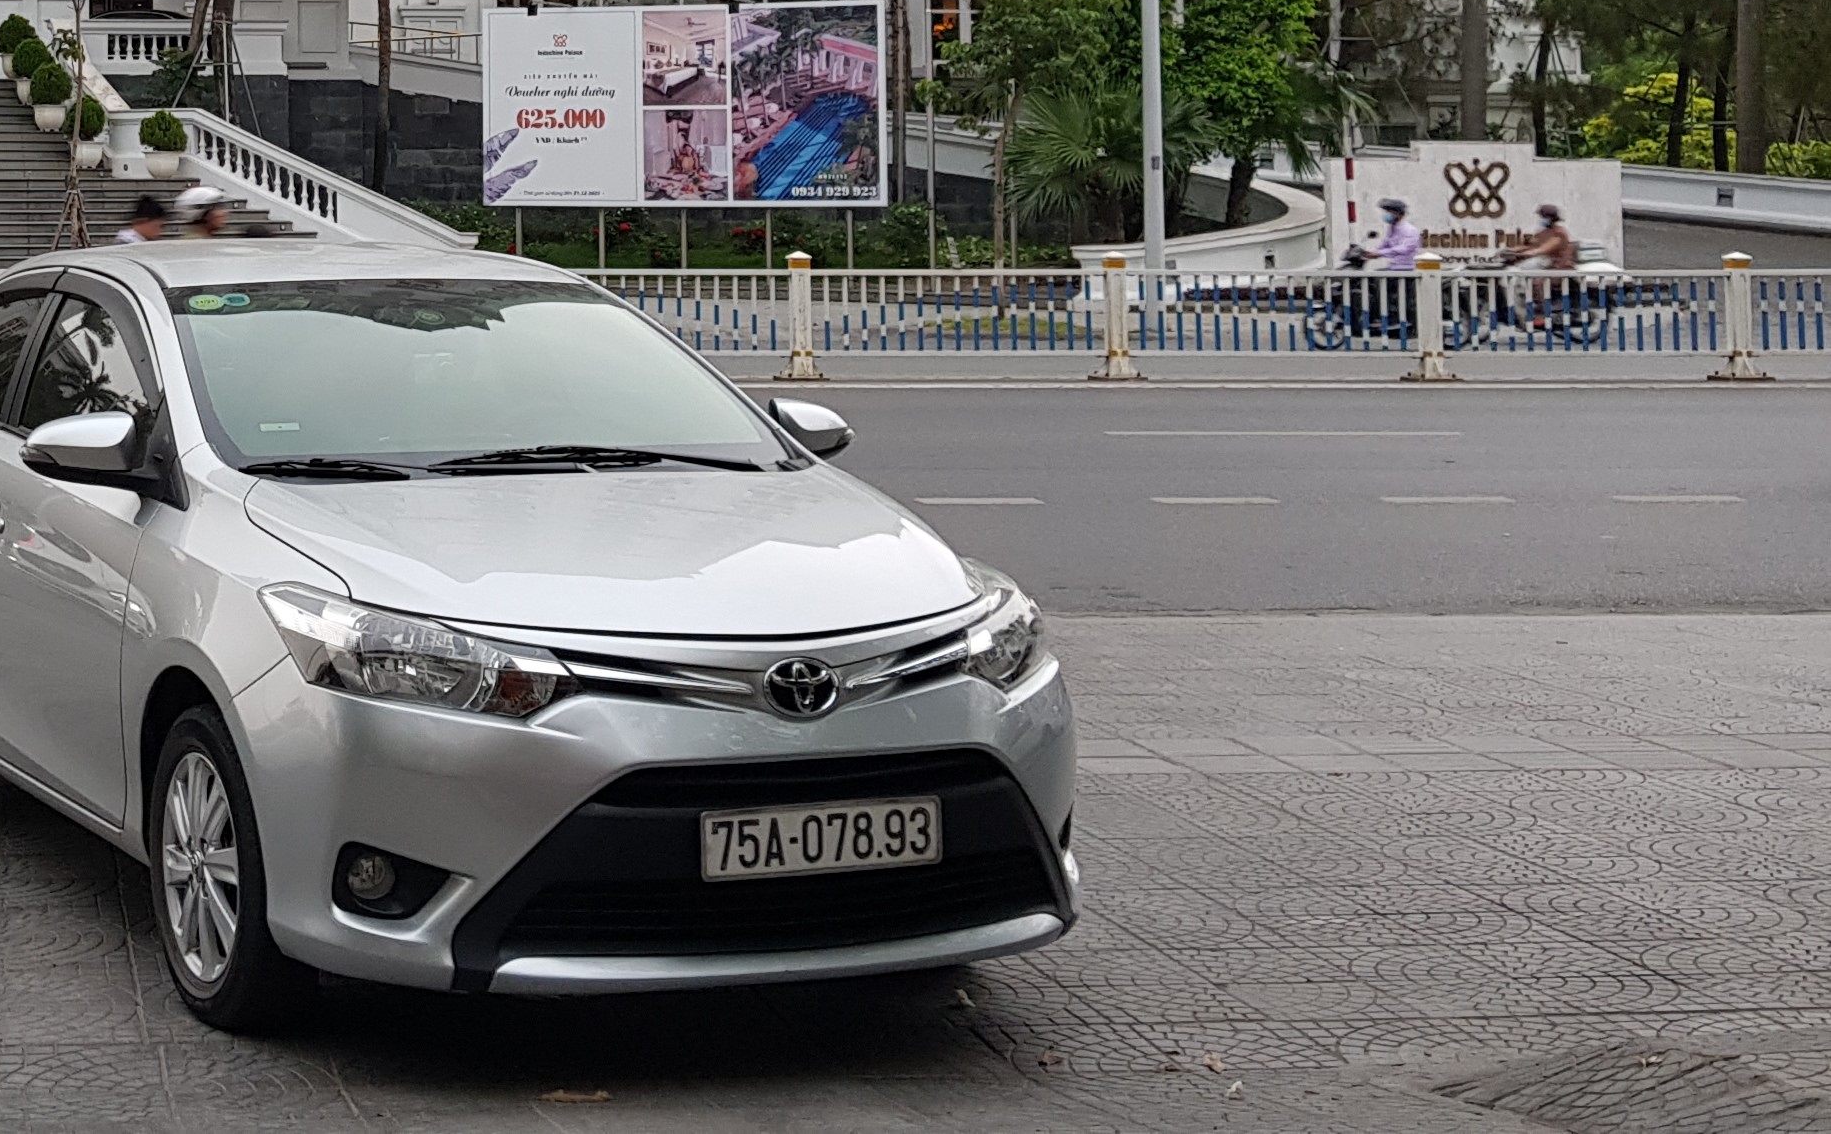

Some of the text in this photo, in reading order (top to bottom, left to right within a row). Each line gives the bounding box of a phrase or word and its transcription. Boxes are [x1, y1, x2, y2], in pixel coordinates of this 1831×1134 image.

[505, 85, 551, 98] Voucher
[516, 108, 606, 129] 625.000
[791, 186, 877, 197] 0934 929 923
[711, 807, 931, 871] 75A-078.93
